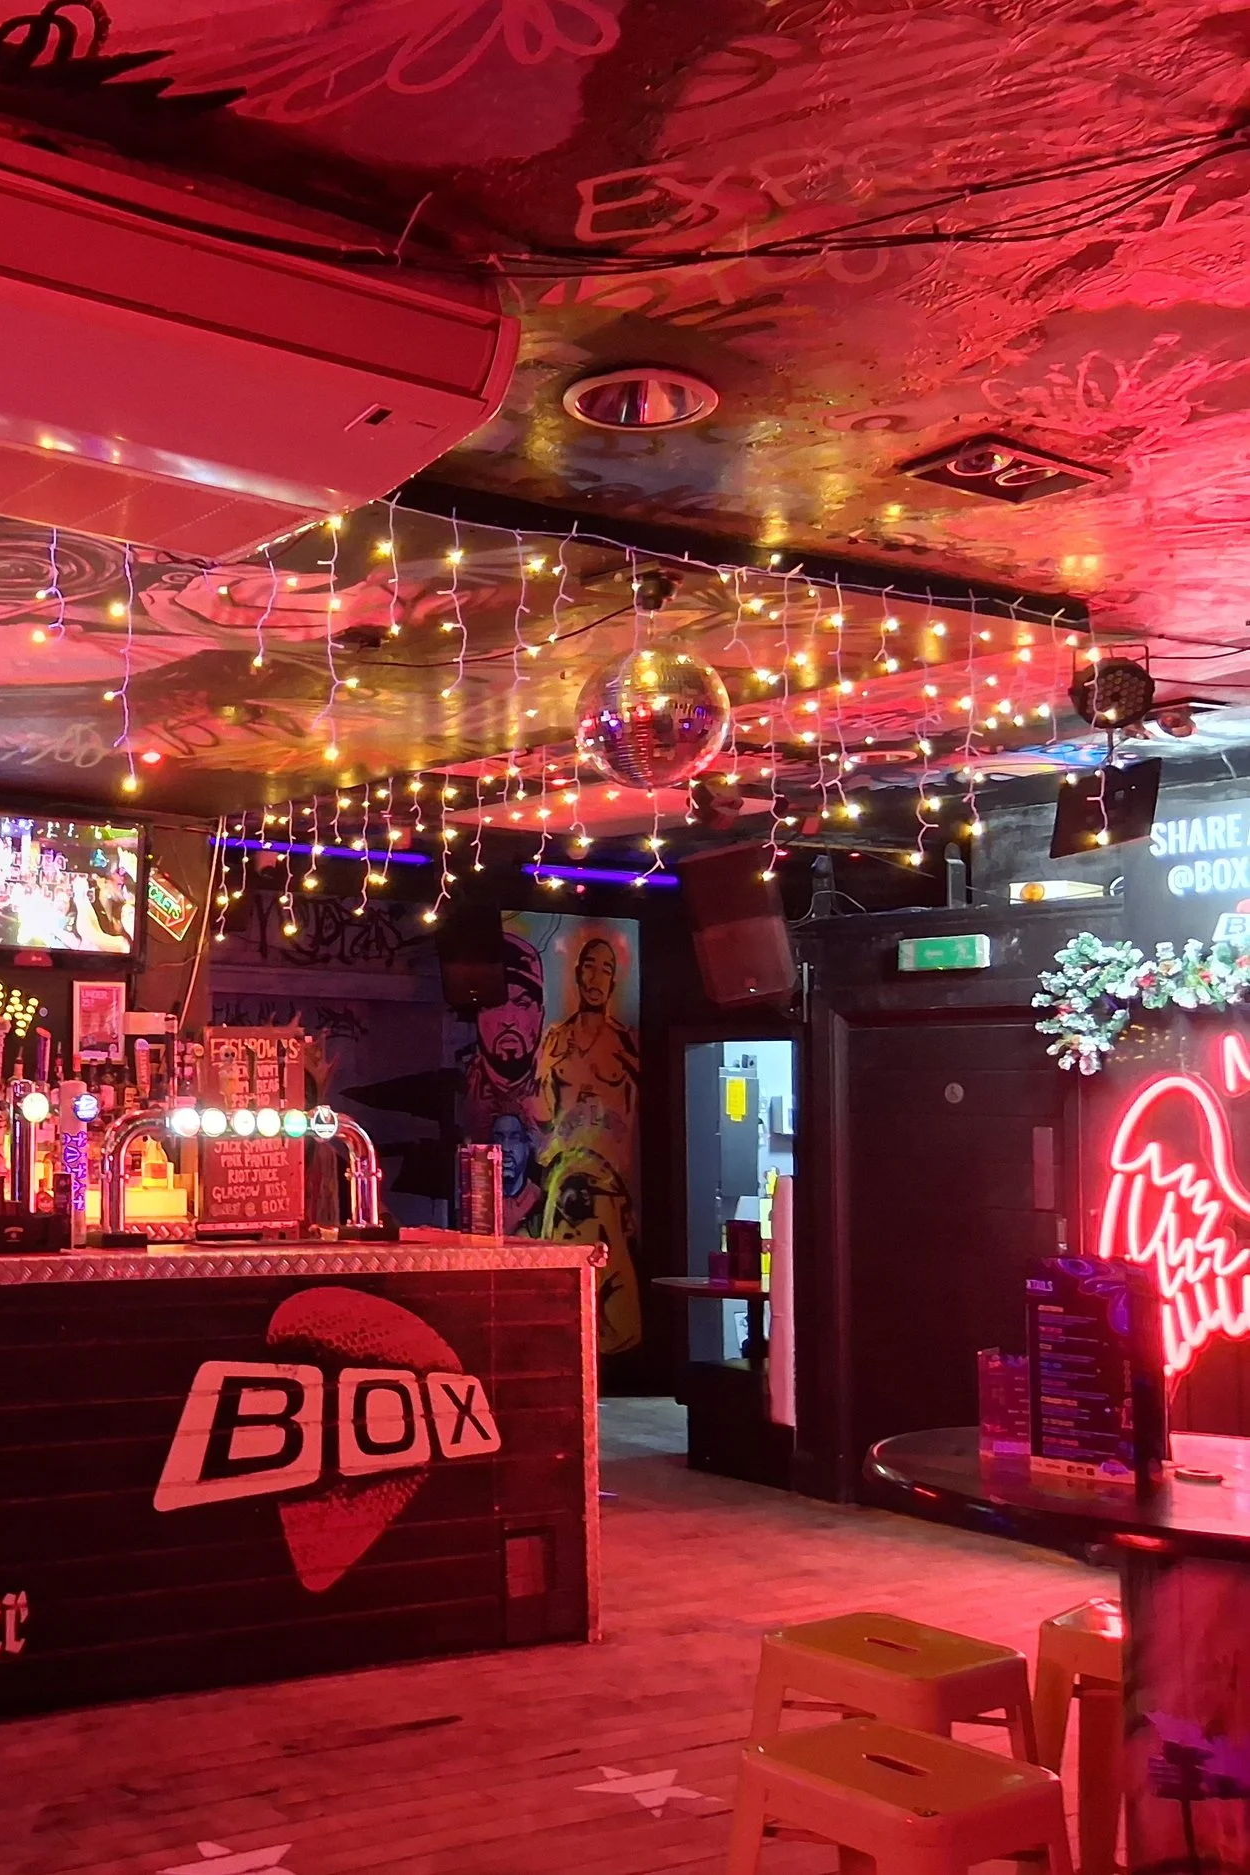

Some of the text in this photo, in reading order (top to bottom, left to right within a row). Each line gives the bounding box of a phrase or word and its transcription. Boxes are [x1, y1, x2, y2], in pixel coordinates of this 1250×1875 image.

[1149, 814, 1242, 857] SHARE
[210, 1038, 299, 1061] FSHBOWS
[231, 1093, 271, 1109] PSYHO
[214, 1141, 241, 1153] JACK
[221, 1152, 289, 1168] PINK PANTHER
[228, 1169, 279, 1184] RIOT JUICE
[212, 1181, 287, 1203] GLASGOW KISS
[261, 1198, 290, 1214] BOX!
[193, 1372, 494, 1484] BOX
